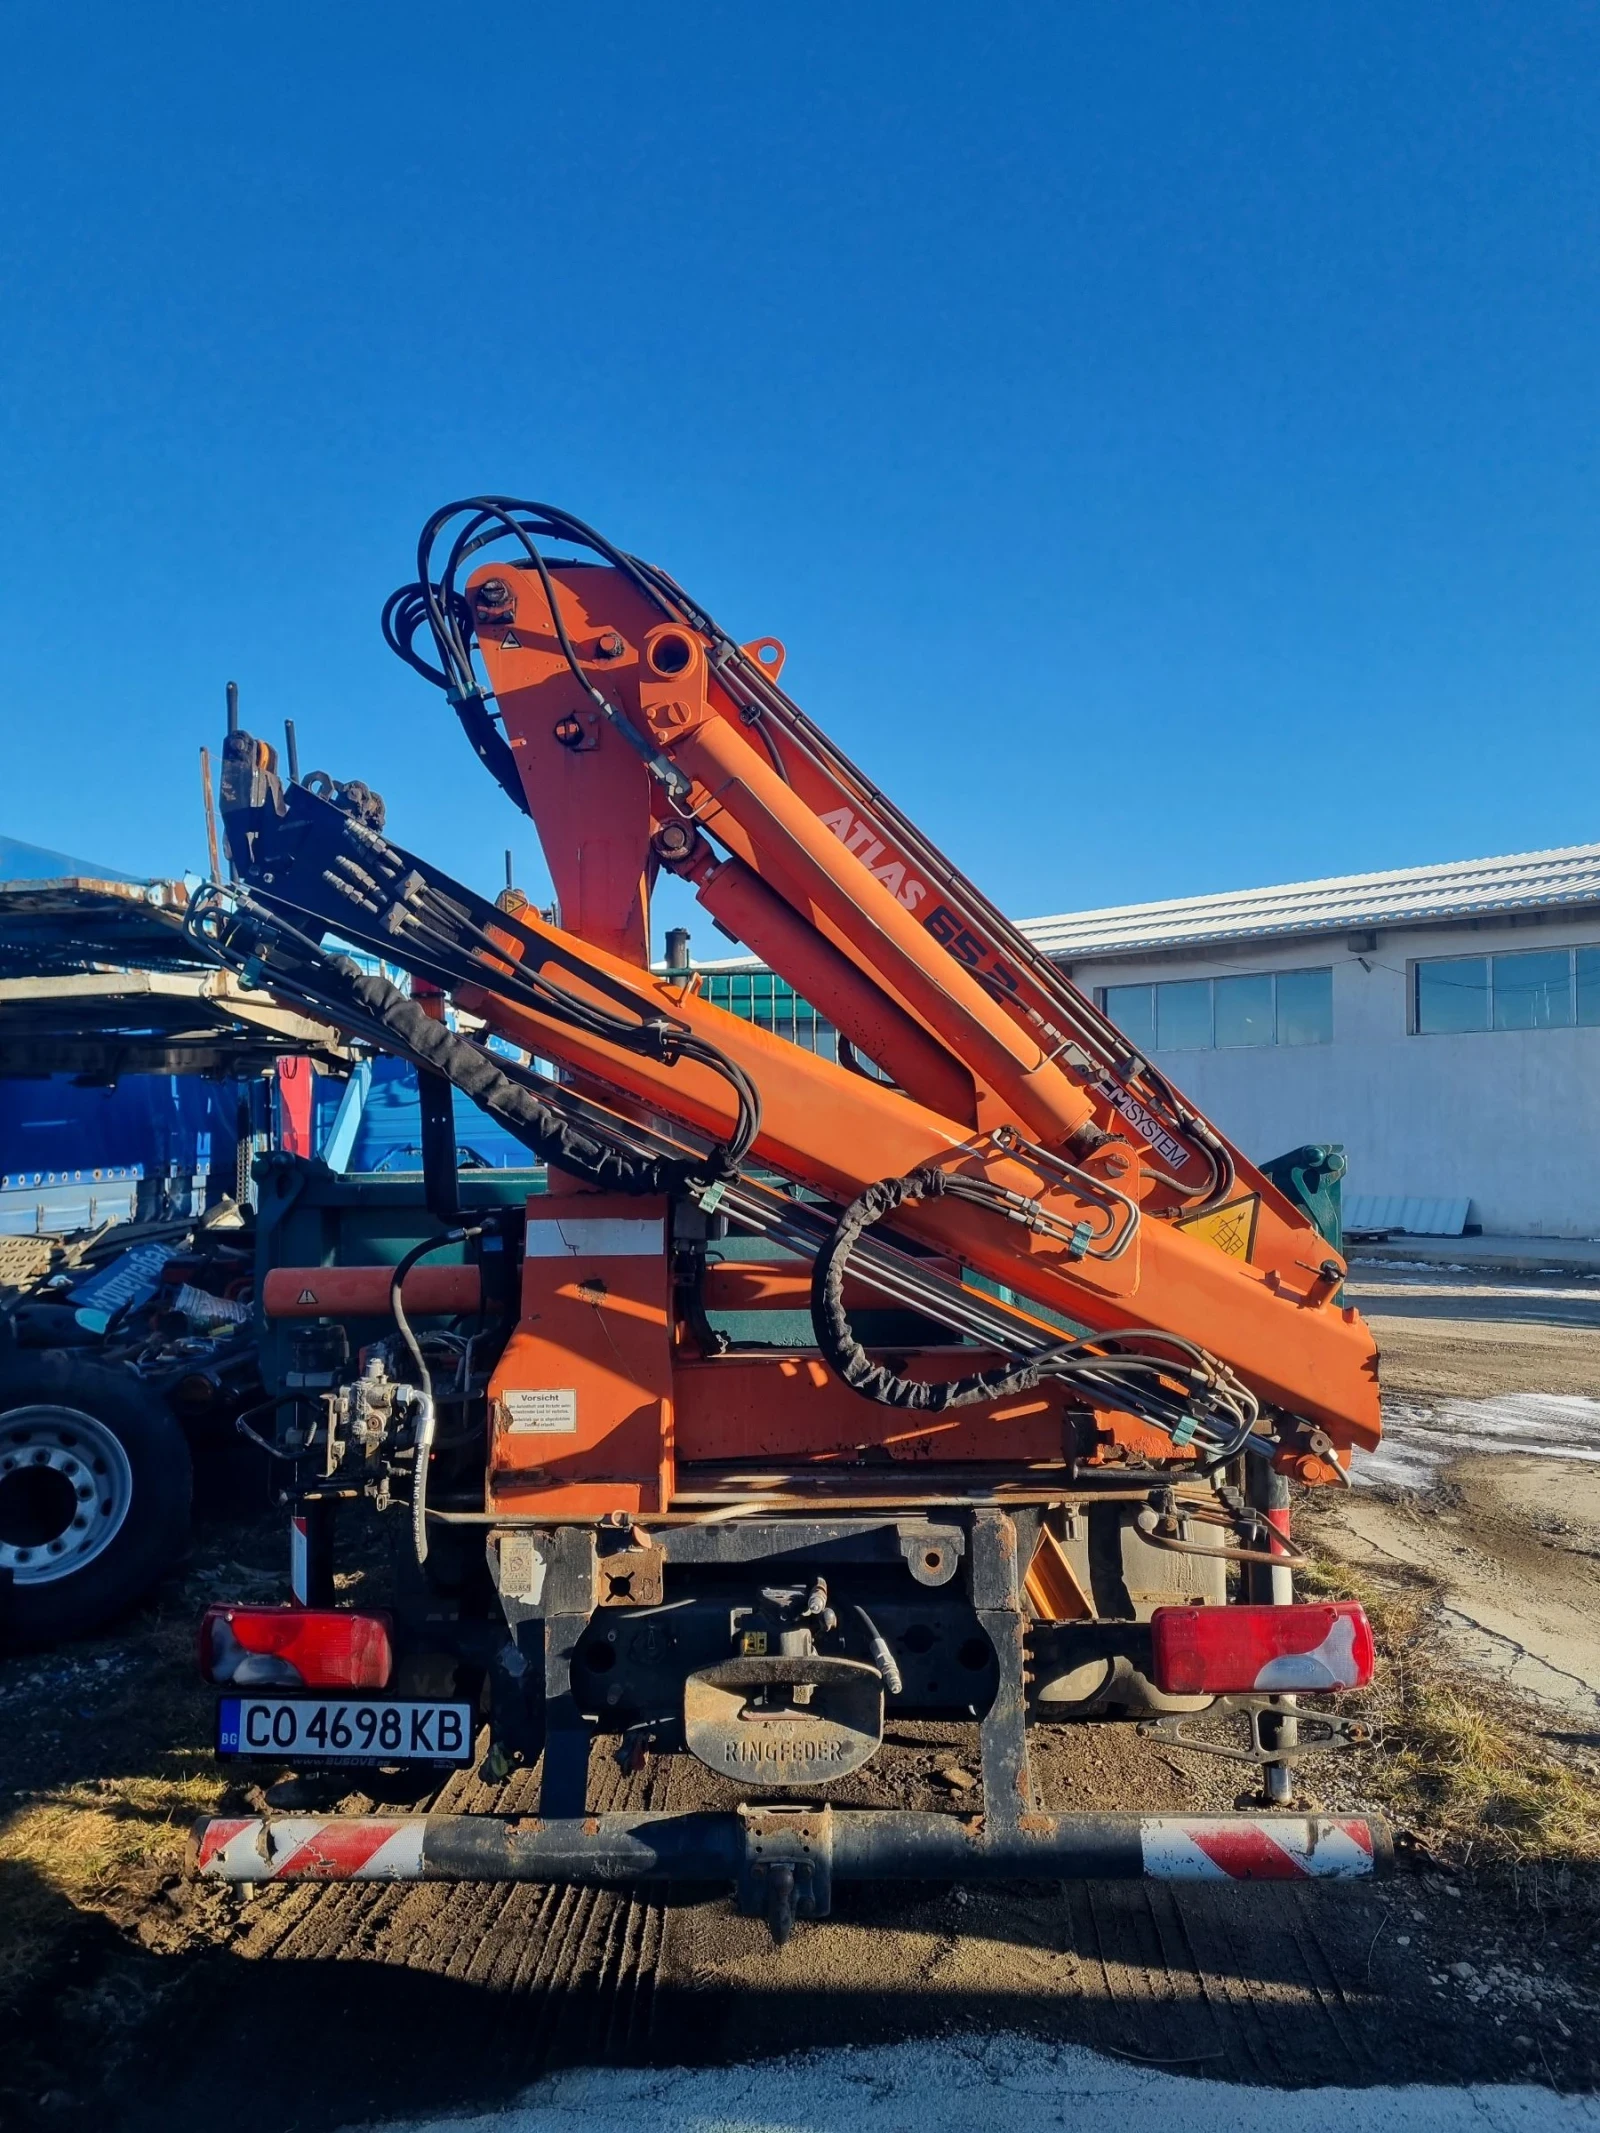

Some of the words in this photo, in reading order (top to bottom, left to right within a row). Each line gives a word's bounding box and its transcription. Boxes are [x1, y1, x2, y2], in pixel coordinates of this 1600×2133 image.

[817, 806, 927, 911] ATLAS
[1125, 1103, 1188, 1167] SYSTEM
[521, 1394, 559, 1402] Vorsicht
[414, 1475, 422, 1485] 19
[221, 1732, 238, 1745] BG
[246, 1705, 297, 1747] CO
[305, 1707, 402, 1750] 4698
[410, 1709, 463, 1752] KB
[724, 1740, 843, 1762] RINGFEDER
